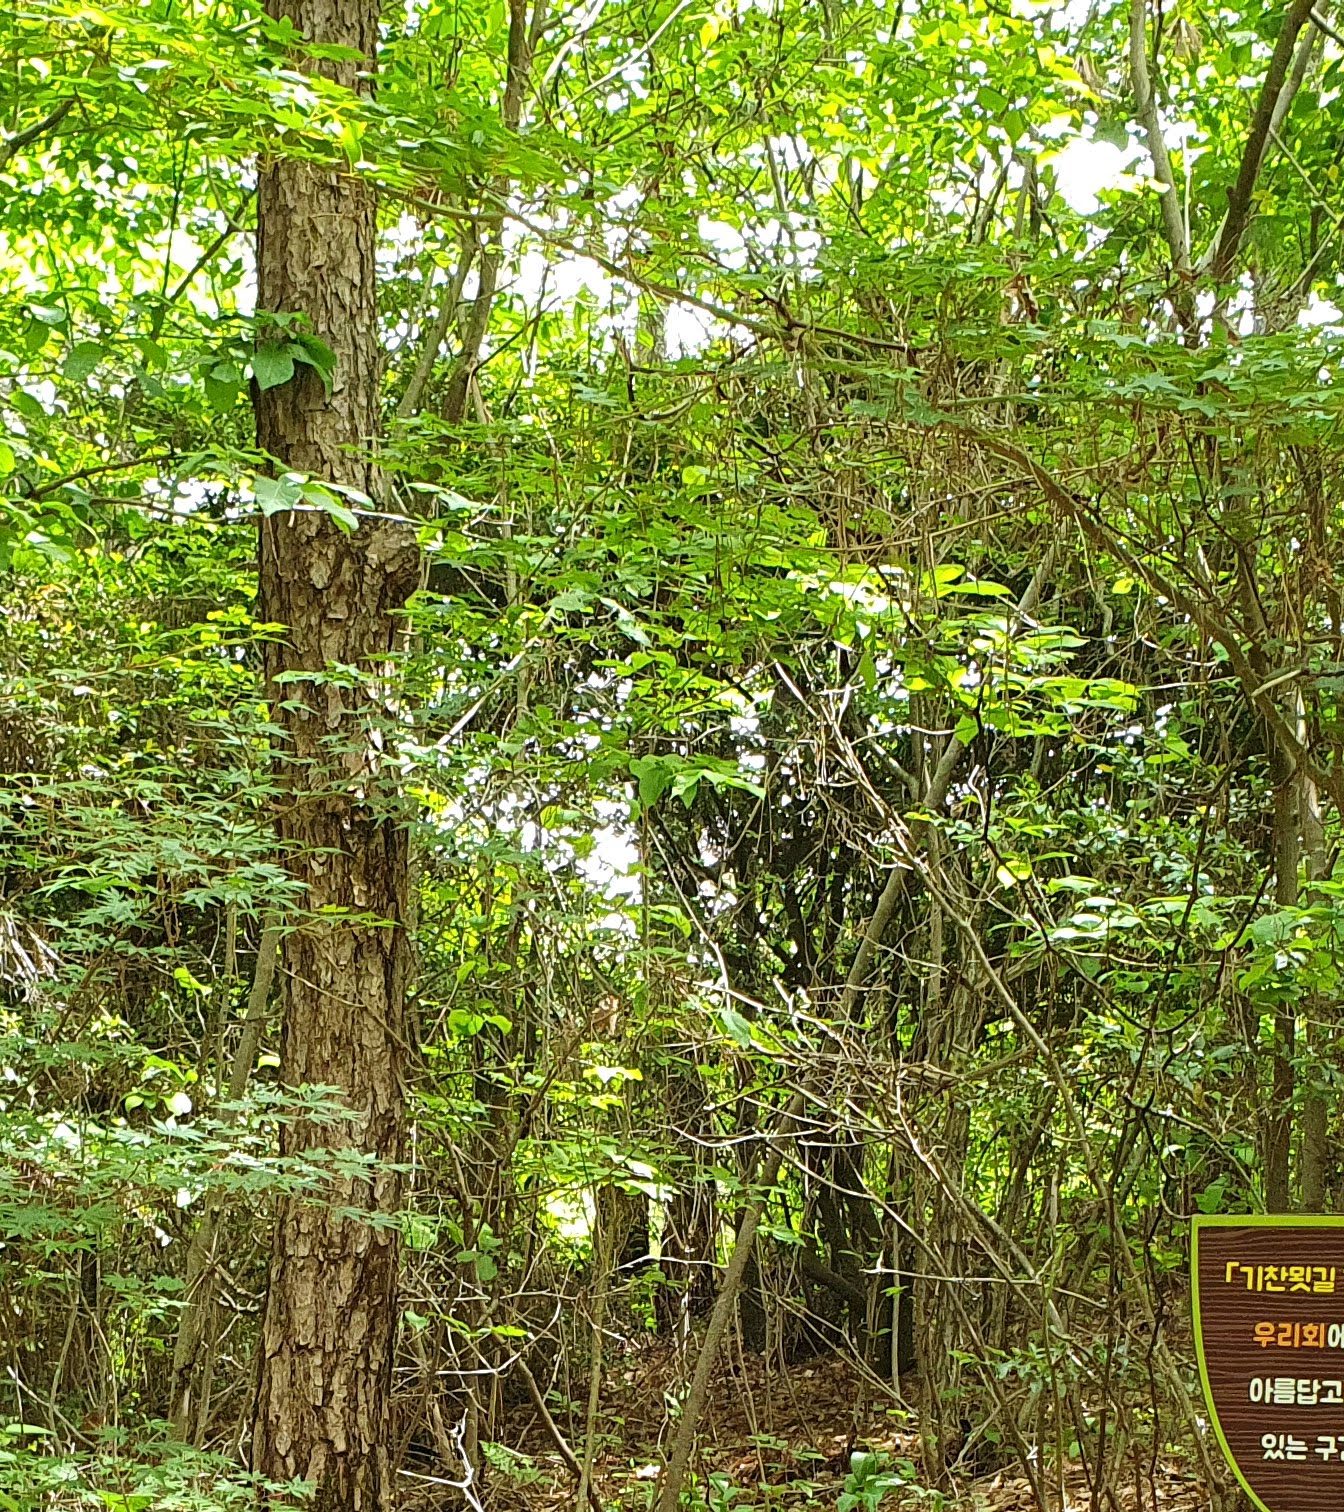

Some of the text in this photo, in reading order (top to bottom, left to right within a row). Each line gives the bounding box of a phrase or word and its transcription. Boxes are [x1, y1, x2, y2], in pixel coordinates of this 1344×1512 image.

[1225, 1262, 1336, 1293] 「기찬묏길
[1249, 1377, 1344, 1405] 아름답고
[1261, 1433, 1308, 1461] 있는
